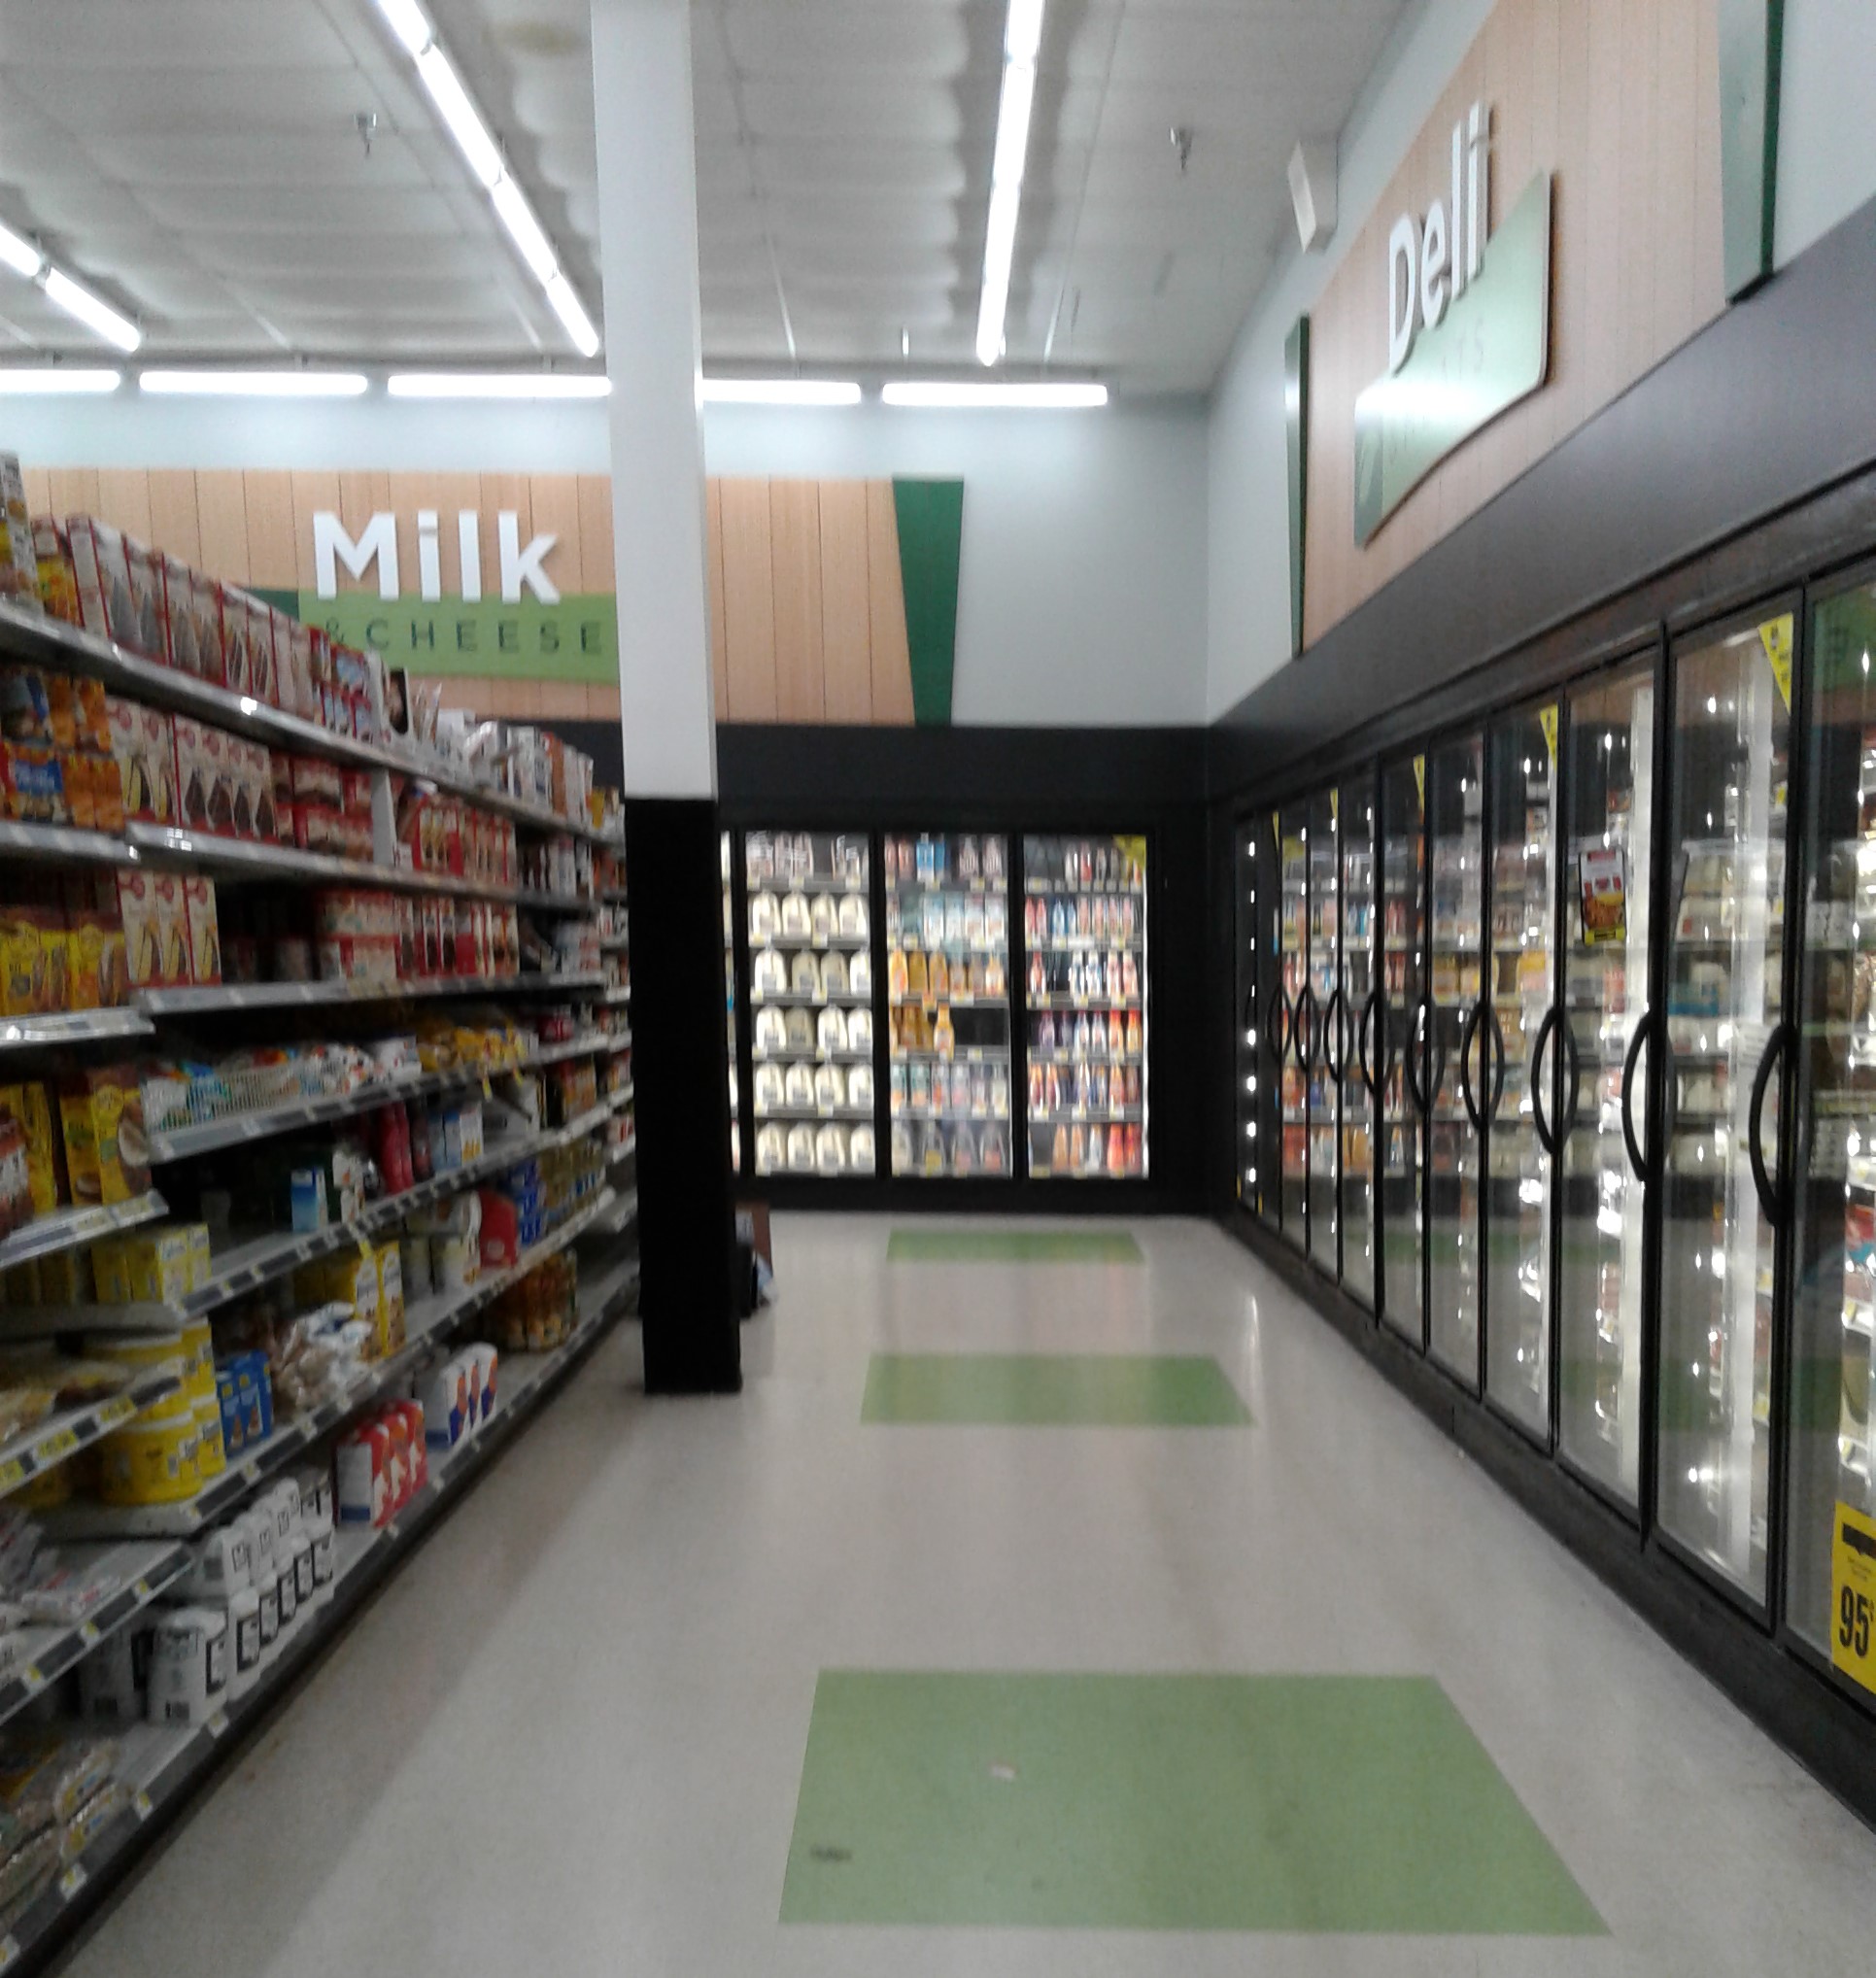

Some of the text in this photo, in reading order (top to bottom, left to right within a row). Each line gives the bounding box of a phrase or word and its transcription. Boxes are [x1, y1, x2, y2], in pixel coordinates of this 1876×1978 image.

[1389, 98, 1491, 376] Deli
[312, 509, 562, 605] Milk
[324, 617, 602, 655] & CHEESE
